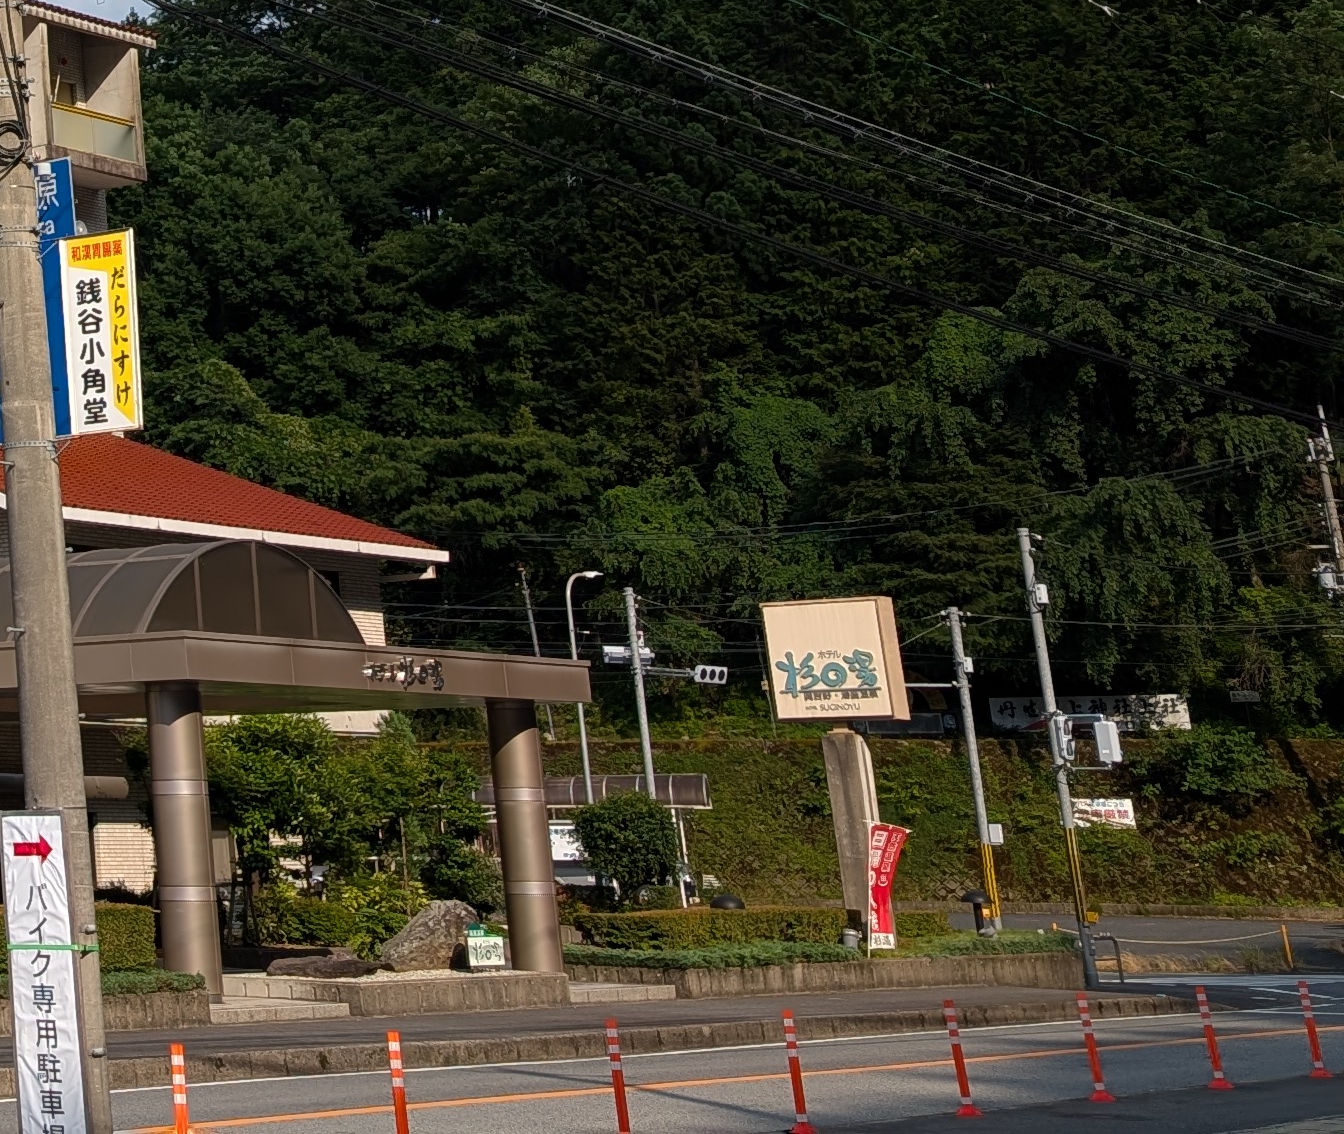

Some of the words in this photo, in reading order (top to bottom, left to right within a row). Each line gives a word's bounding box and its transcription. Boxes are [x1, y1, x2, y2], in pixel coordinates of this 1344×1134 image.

[75, 277, 109, 425] 銭谷小角堂
[111, 266, 131, 406] だらにすけ
[775, 649, 879, 699] 杉の湯
[817, 650, 841, 659] ホテル
[997, 697, 1181, 719] 丹生上神社上社
